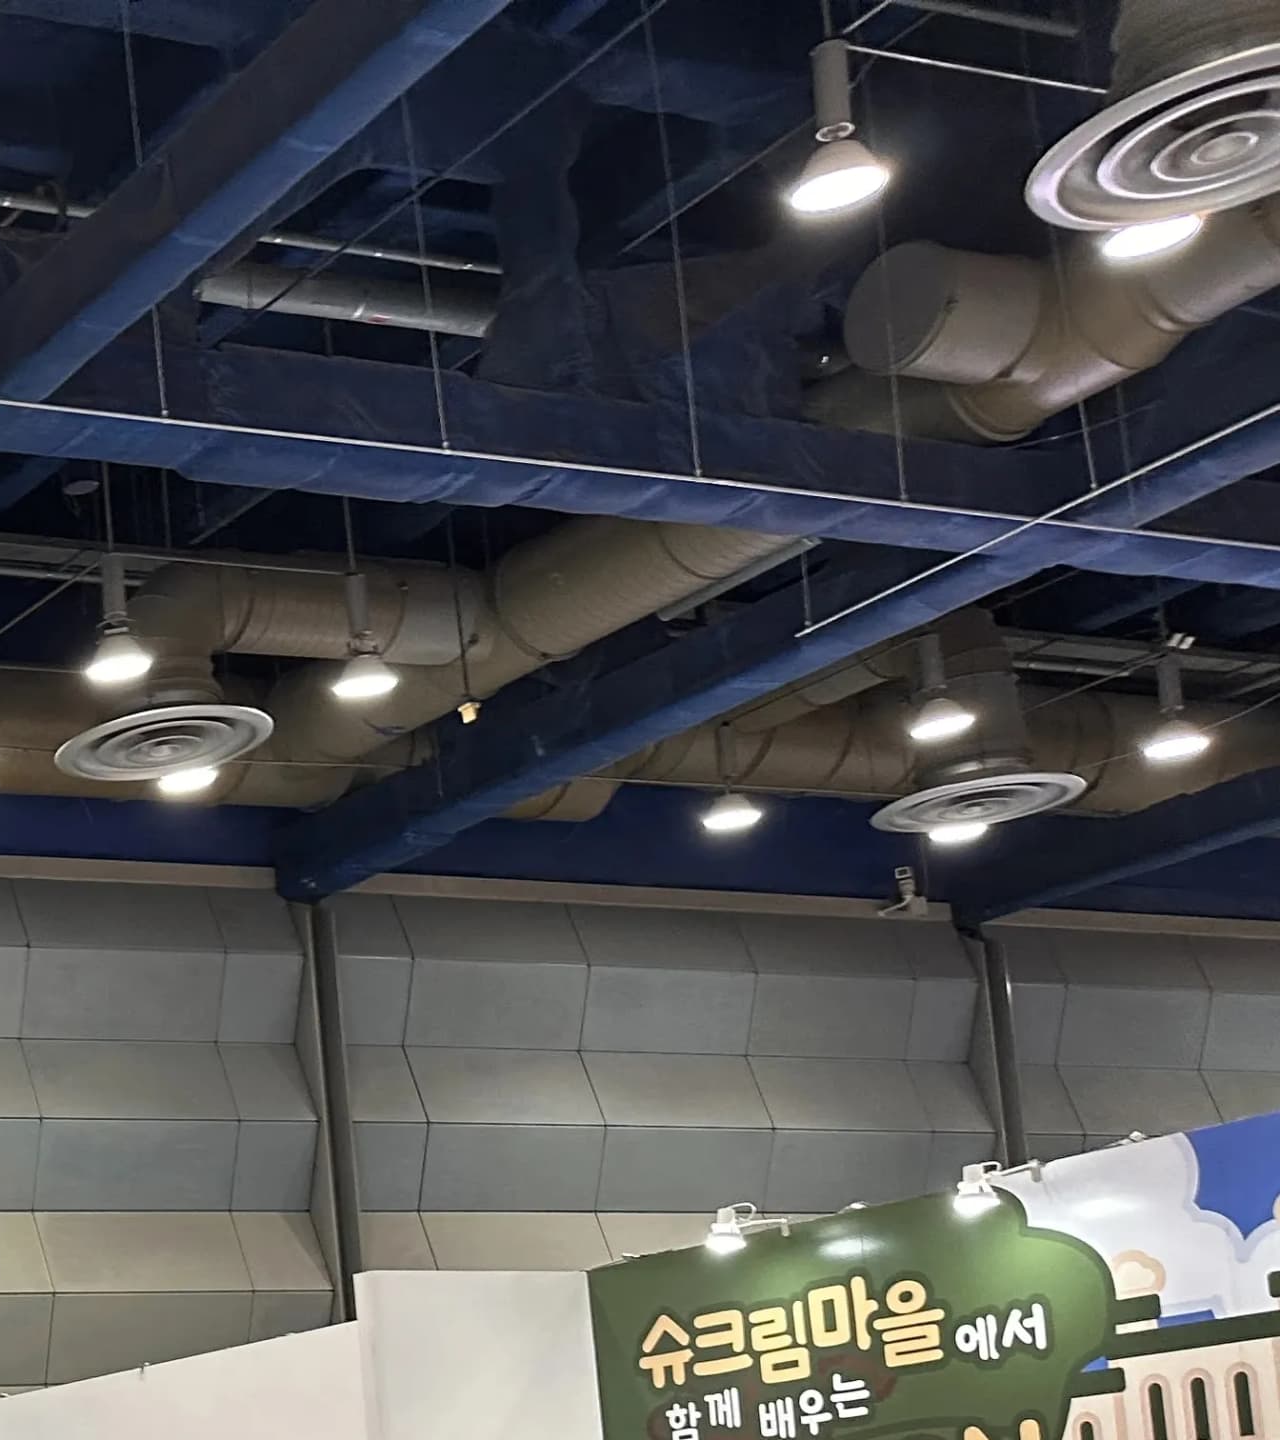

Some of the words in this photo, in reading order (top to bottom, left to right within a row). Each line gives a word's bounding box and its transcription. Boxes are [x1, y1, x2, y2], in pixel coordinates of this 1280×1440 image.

[639, 1276, 945, 1388] 슈크림마을
[955, 1303, 1048, 1361] 에서
[758, 1373, 870, 1440] 배우는
